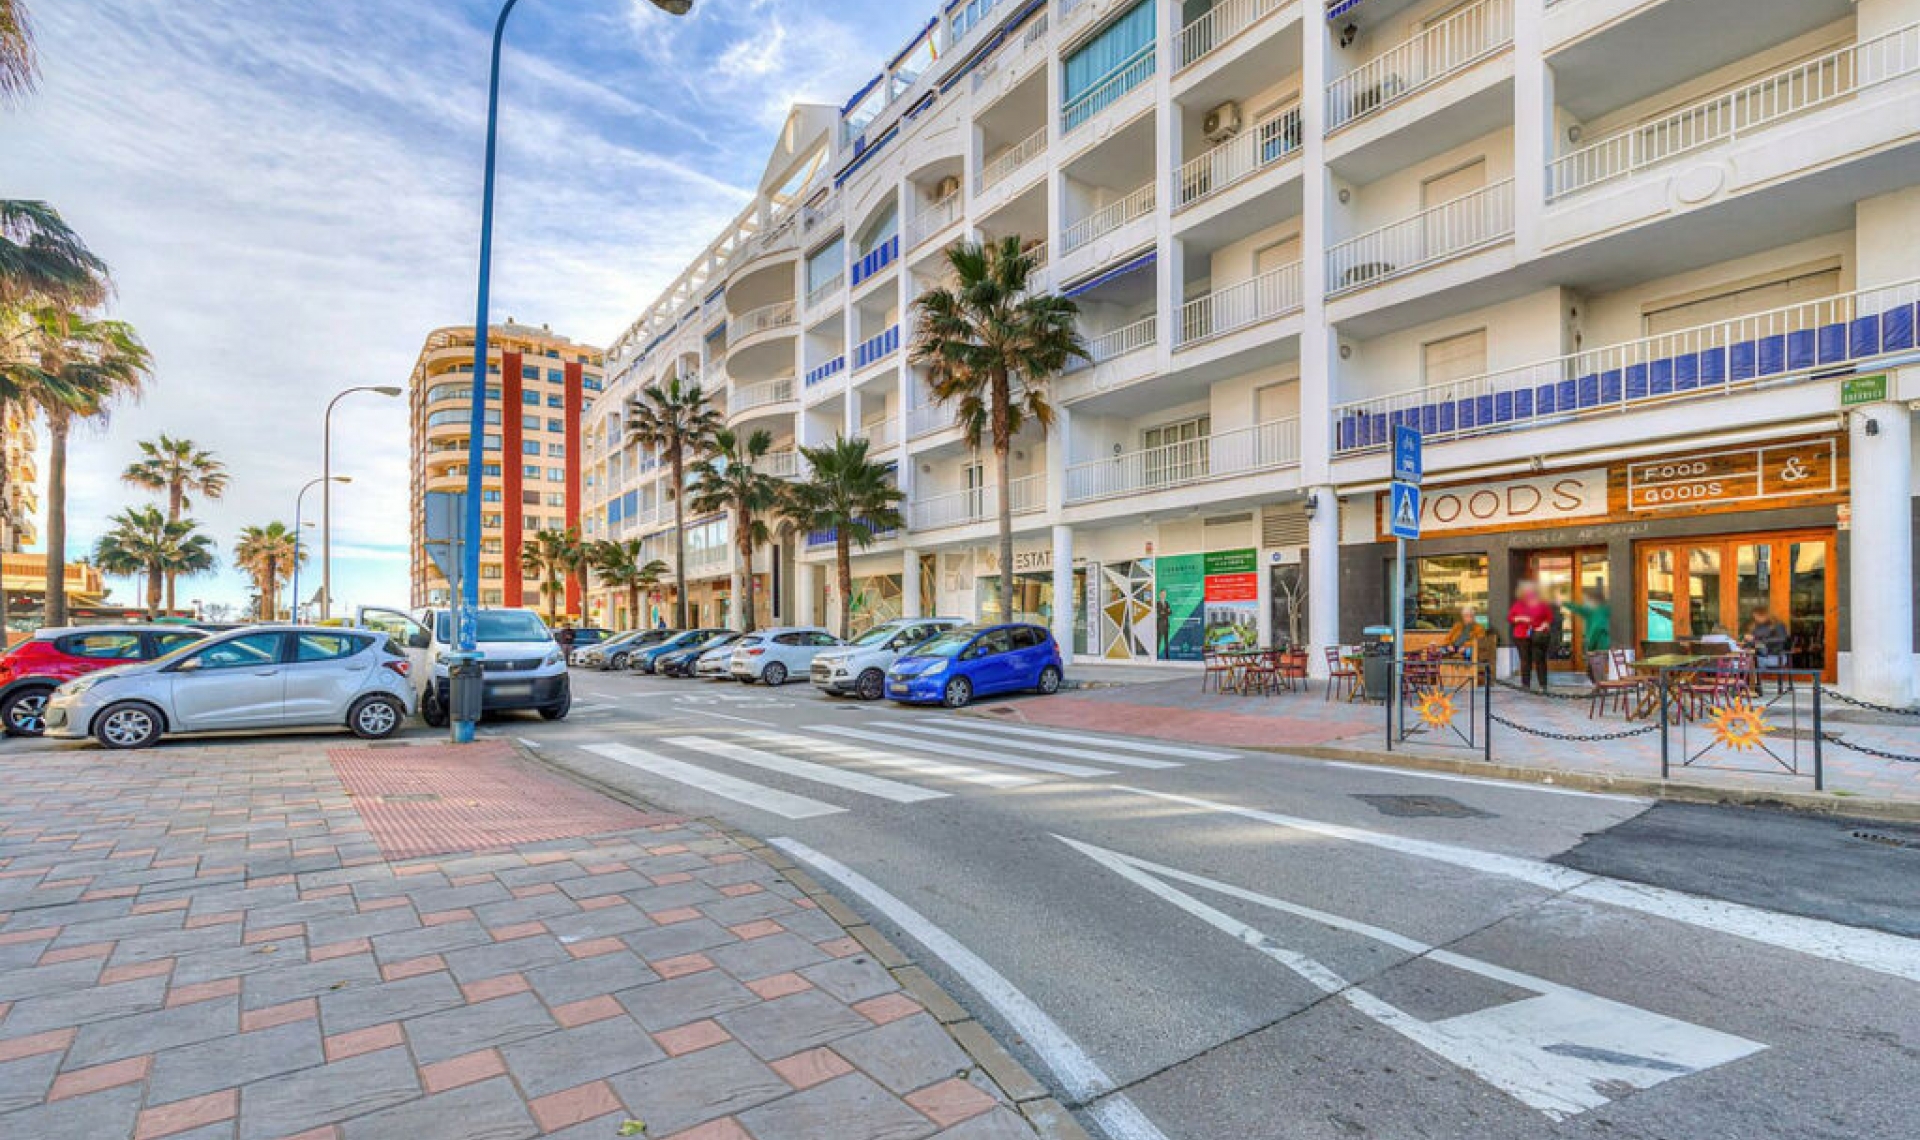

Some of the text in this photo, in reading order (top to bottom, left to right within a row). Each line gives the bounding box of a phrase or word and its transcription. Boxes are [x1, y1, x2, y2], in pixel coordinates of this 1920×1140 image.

[1644, 462, 1708, 481] FOOD
[1781, 456, 1809, 482] &
[1420, 479, 1584, 523] OODS
[1645, 482, 1724, 503] GOODS
[1016, 551, 1052, 570] ESTAT
